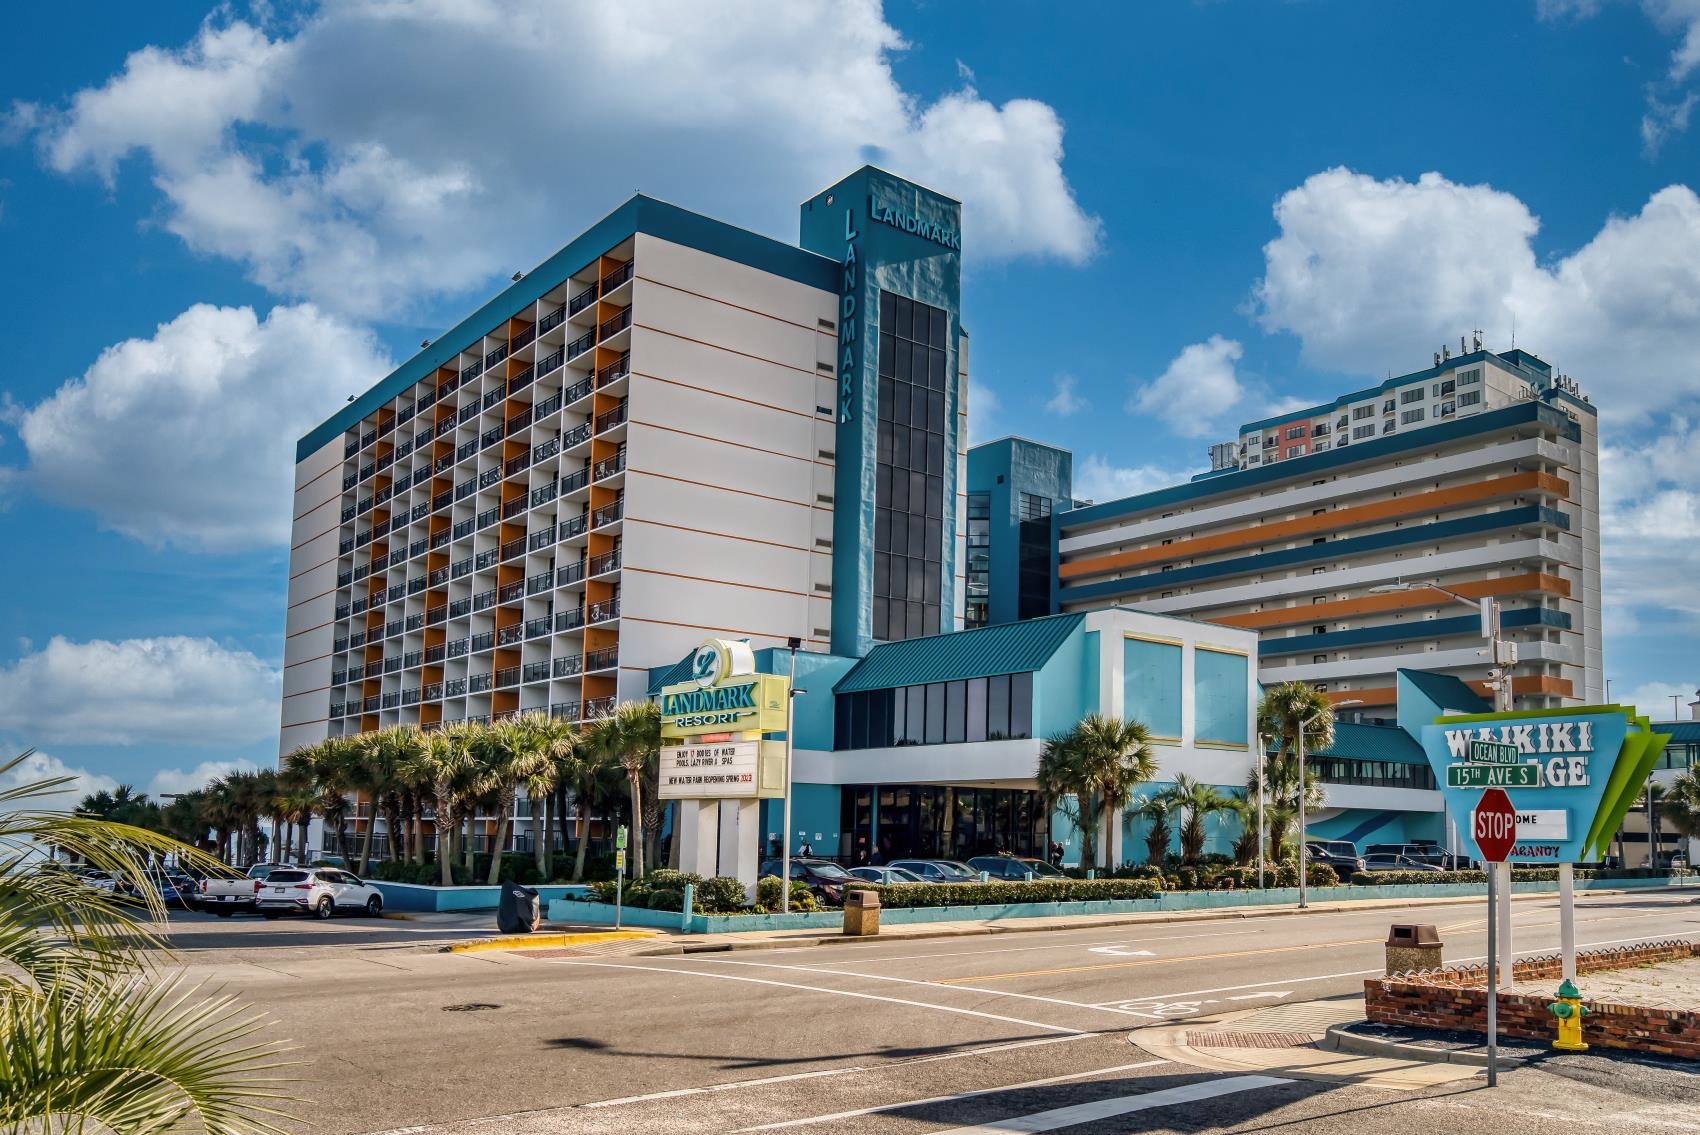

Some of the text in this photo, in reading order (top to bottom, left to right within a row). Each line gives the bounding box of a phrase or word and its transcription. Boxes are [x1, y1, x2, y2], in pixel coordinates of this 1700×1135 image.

[871, 195, 960, 250] LANDMARK
[841, 209, 857, 424] LANDMARK
[662, 683, 758, 717] LANDMARK
[675, 712, 737, 728] RESORT
[697, 749, 711, 757] BODIES
[1474, 744, 1516, 764] OCEAN BLVD
[679, 776, 691, 784] WATER
[704, 775, 724, 783] REOPENING
[726, 774, 739, 782] SPRING
[1457, 768, 1480, 784] 15TH
[1487, 767, 1513, 784] AVE
[1520, 767, 1528, 784] S
[1477, 811, 1513, 839] STOP
